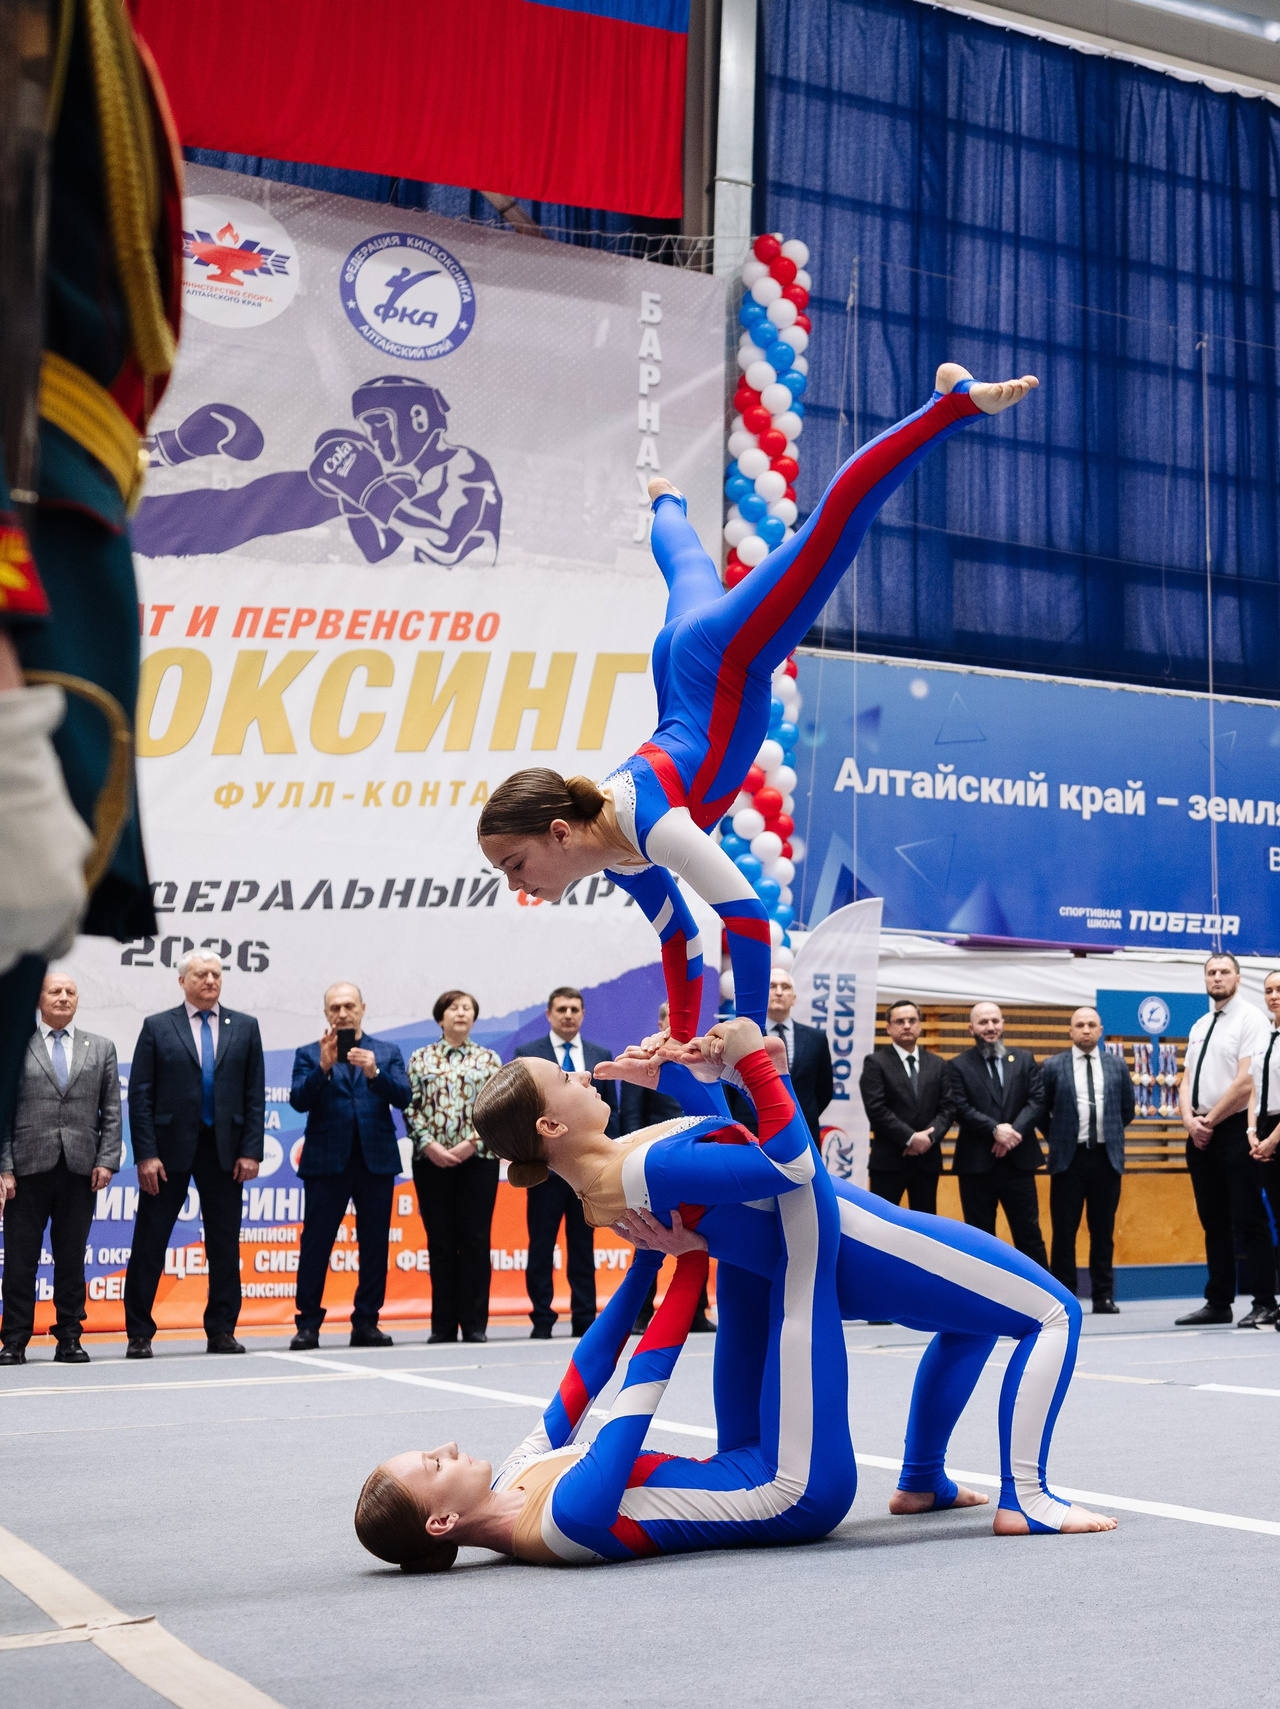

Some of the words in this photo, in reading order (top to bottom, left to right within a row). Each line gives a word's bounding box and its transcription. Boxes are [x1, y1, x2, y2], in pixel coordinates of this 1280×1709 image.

[343, 235, 401, 284] ФЕДЕРАЦИЯ
[405, 235, 474, 304] КИКБОКСИНГА
[241, 290, 274, 304] СПОРТА
[373, 301, 438, 329] ФКА
[358, 323, 425, 359] АЛТАЙСКИЙ
[425, 338, 455, 359] КРАЙ
[323, 442, 354, 475] Cola
[185, 604, 220, 638] И
[231, 606, 502, 643] ПЕРВЕНСТВО
[212, 779, 490, 810] ФУЛЛ-КОНТА
[833, 757, 1049, 809] Алтайский
[1059, 779, 1147, 821] край
[1058, 905, 1123, 919] СПОРТИВНАЯ
[1086, 917, 1123, 930] ШКОЛА
[1129, 909, 1242, 937] ПОБЕДА
[810, 972, 831, 1031] НАЯ
[832, 972, 857, 1102] РОССИЯ
[238, 1227, 298, 1243] ЕМПИОН
